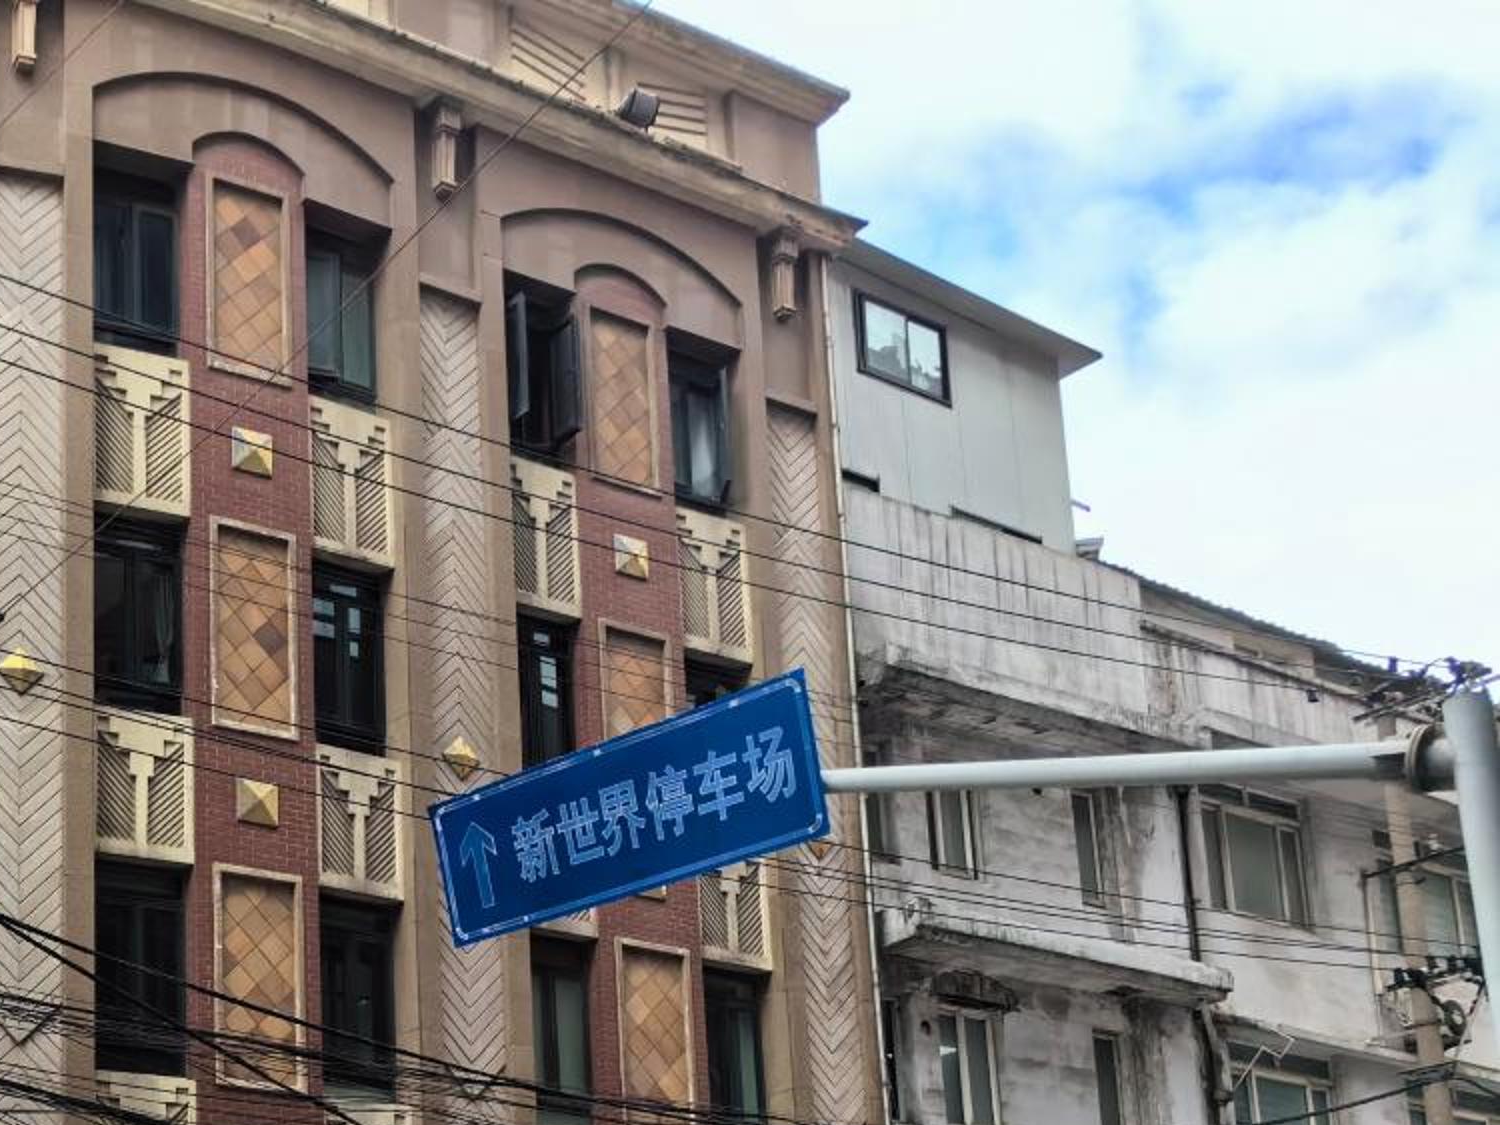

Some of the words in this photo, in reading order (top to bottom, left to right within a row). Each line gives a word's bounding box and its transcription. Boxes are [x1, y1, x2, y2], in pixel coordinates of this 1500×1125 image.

[511, 725, 797, 883] 新世界停车场
